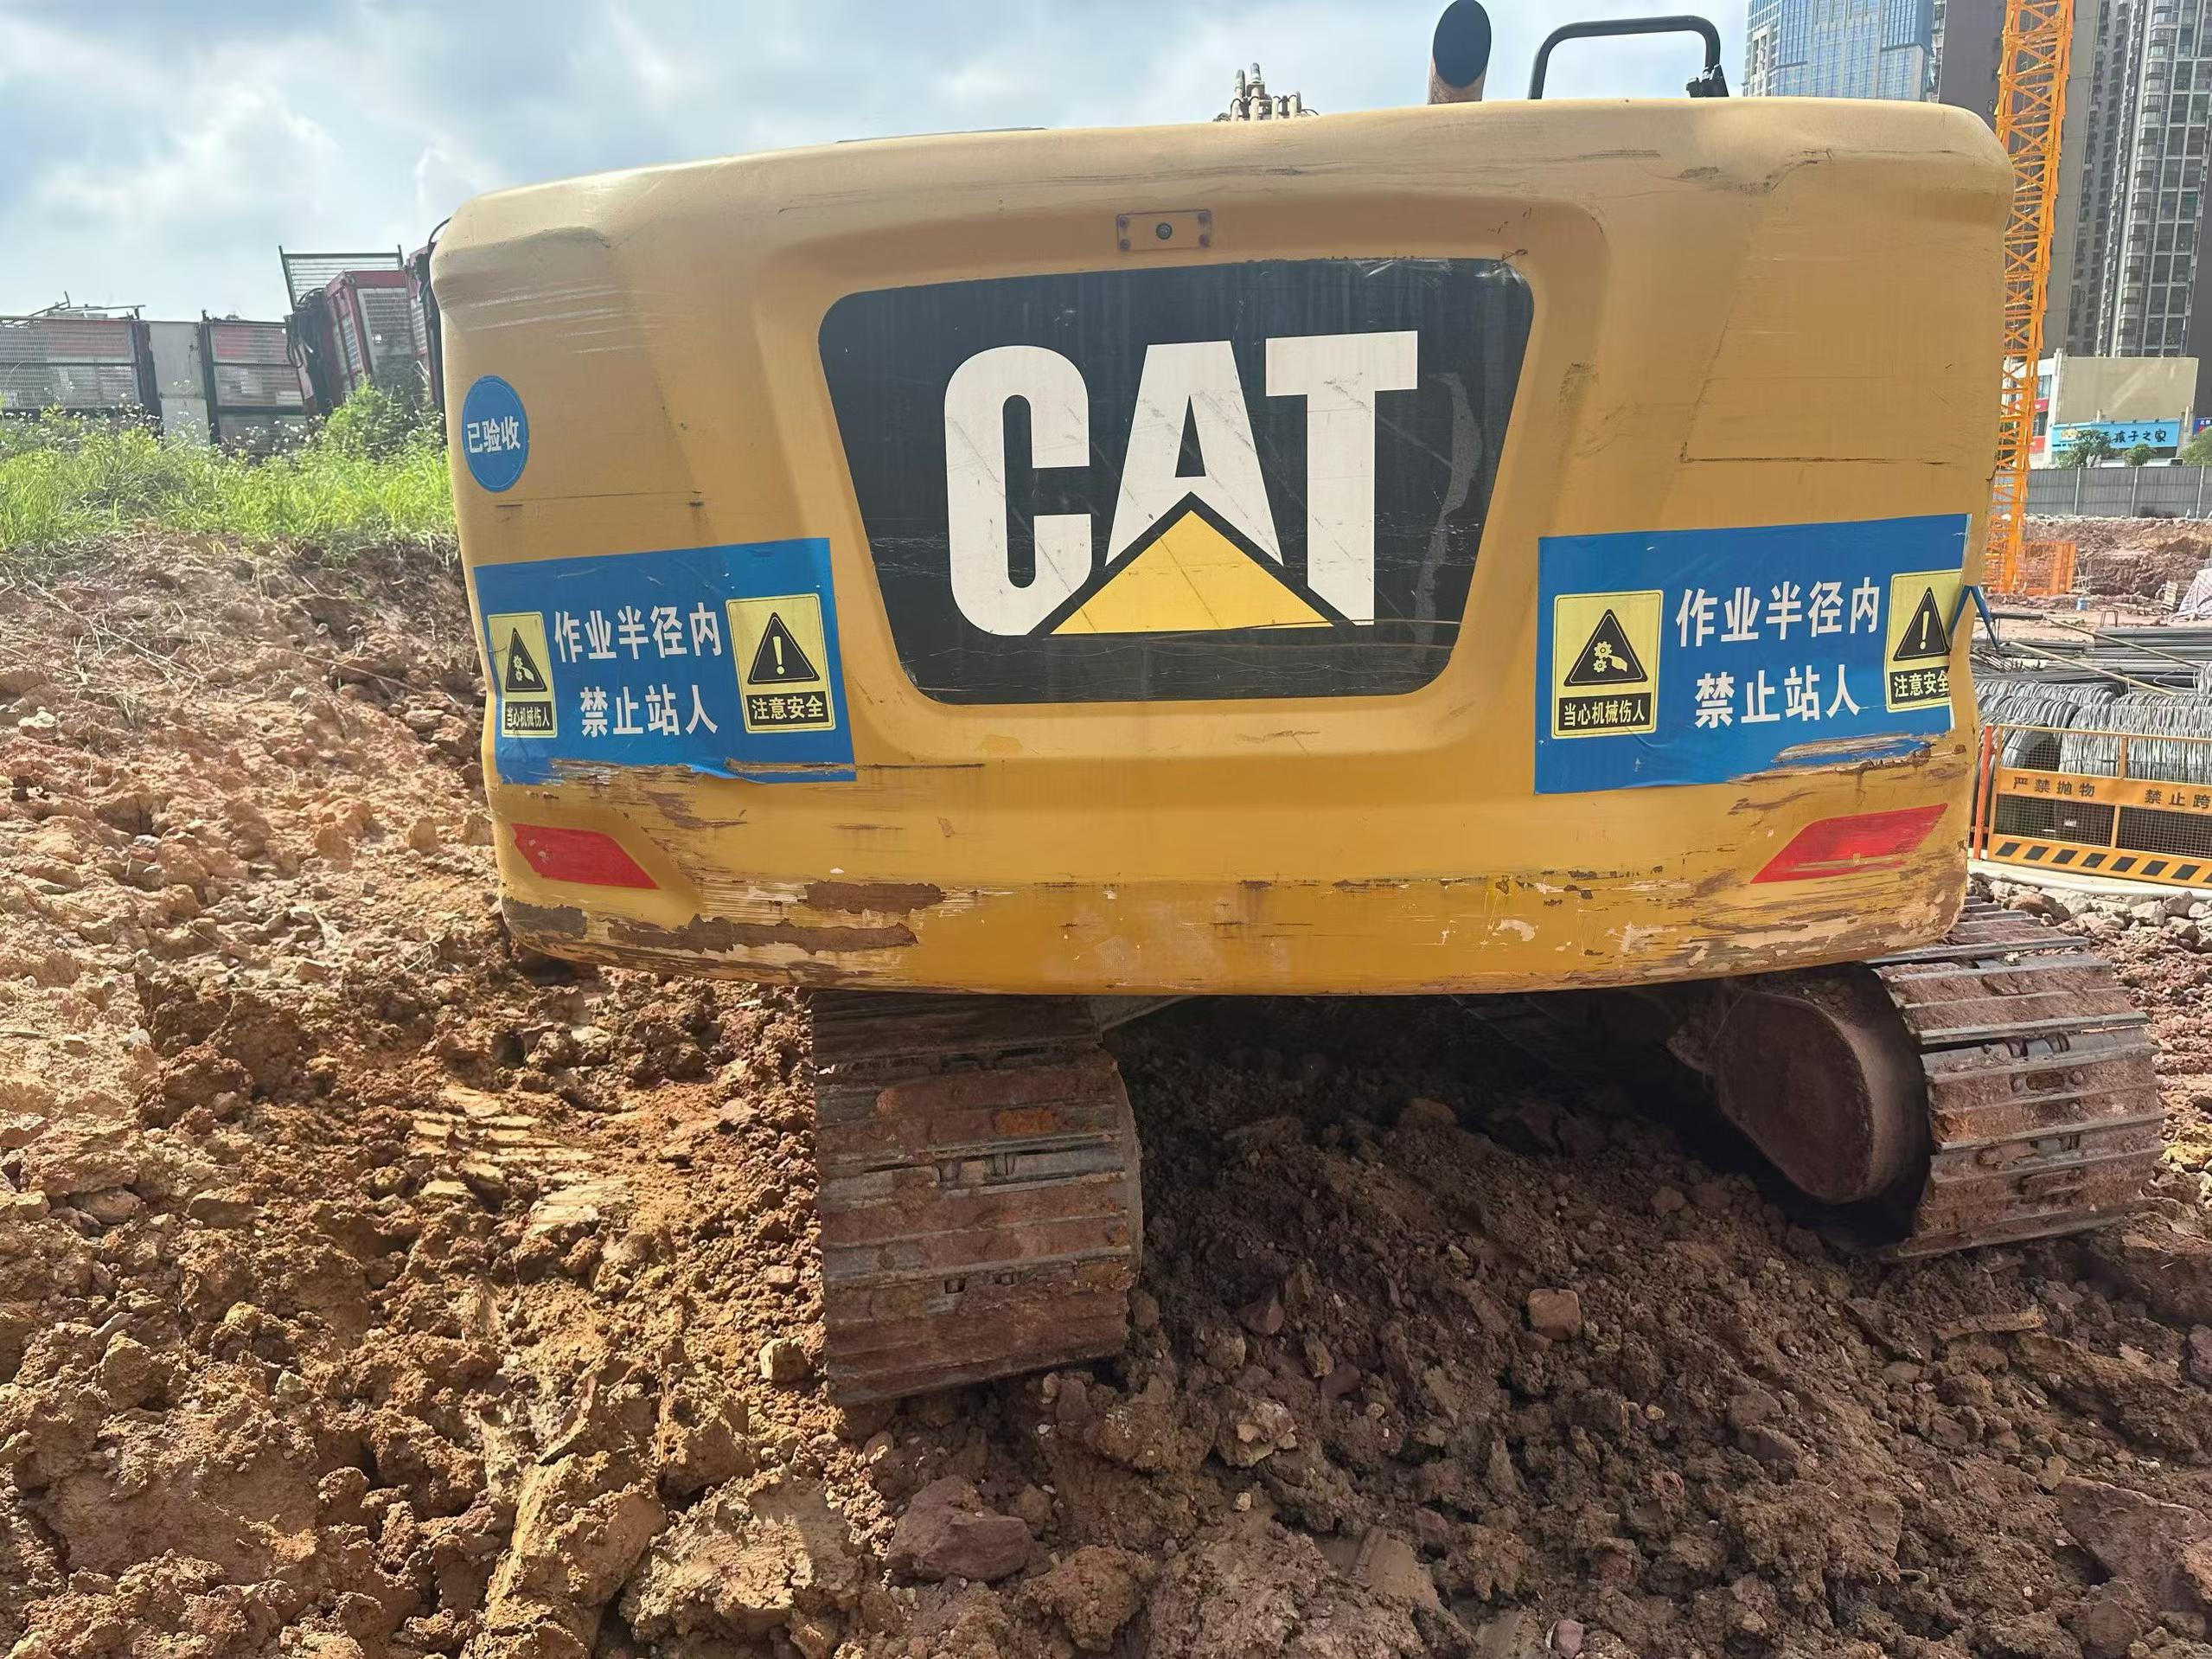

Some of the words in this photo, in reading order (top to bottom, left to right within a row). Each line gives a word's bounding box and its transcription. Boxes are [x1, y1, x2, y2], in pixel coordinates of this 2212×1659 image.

[467, 415, 521, 454] 已验收
[944, 330, 1418, 636] CAT
[1675, 576, 1880, 648] 作业半径内
[553, 602, 722, 663] 作业半径内
[1694, 663, 1861, 729] 禁止站人
[1894, 669, 1950, 698] 注意安全
[506, 706, 551, 727] 当心机械伤人
[579, 684, 719, 738] 禁止站人
[751, 695, 825, 720] 注意安全
[1563, 698, 1646, 727] 当心机械伤人
[2013, 777, 2095, 797] 严禁抛物
[2145, 789, 2211, 810] 禁止跨
